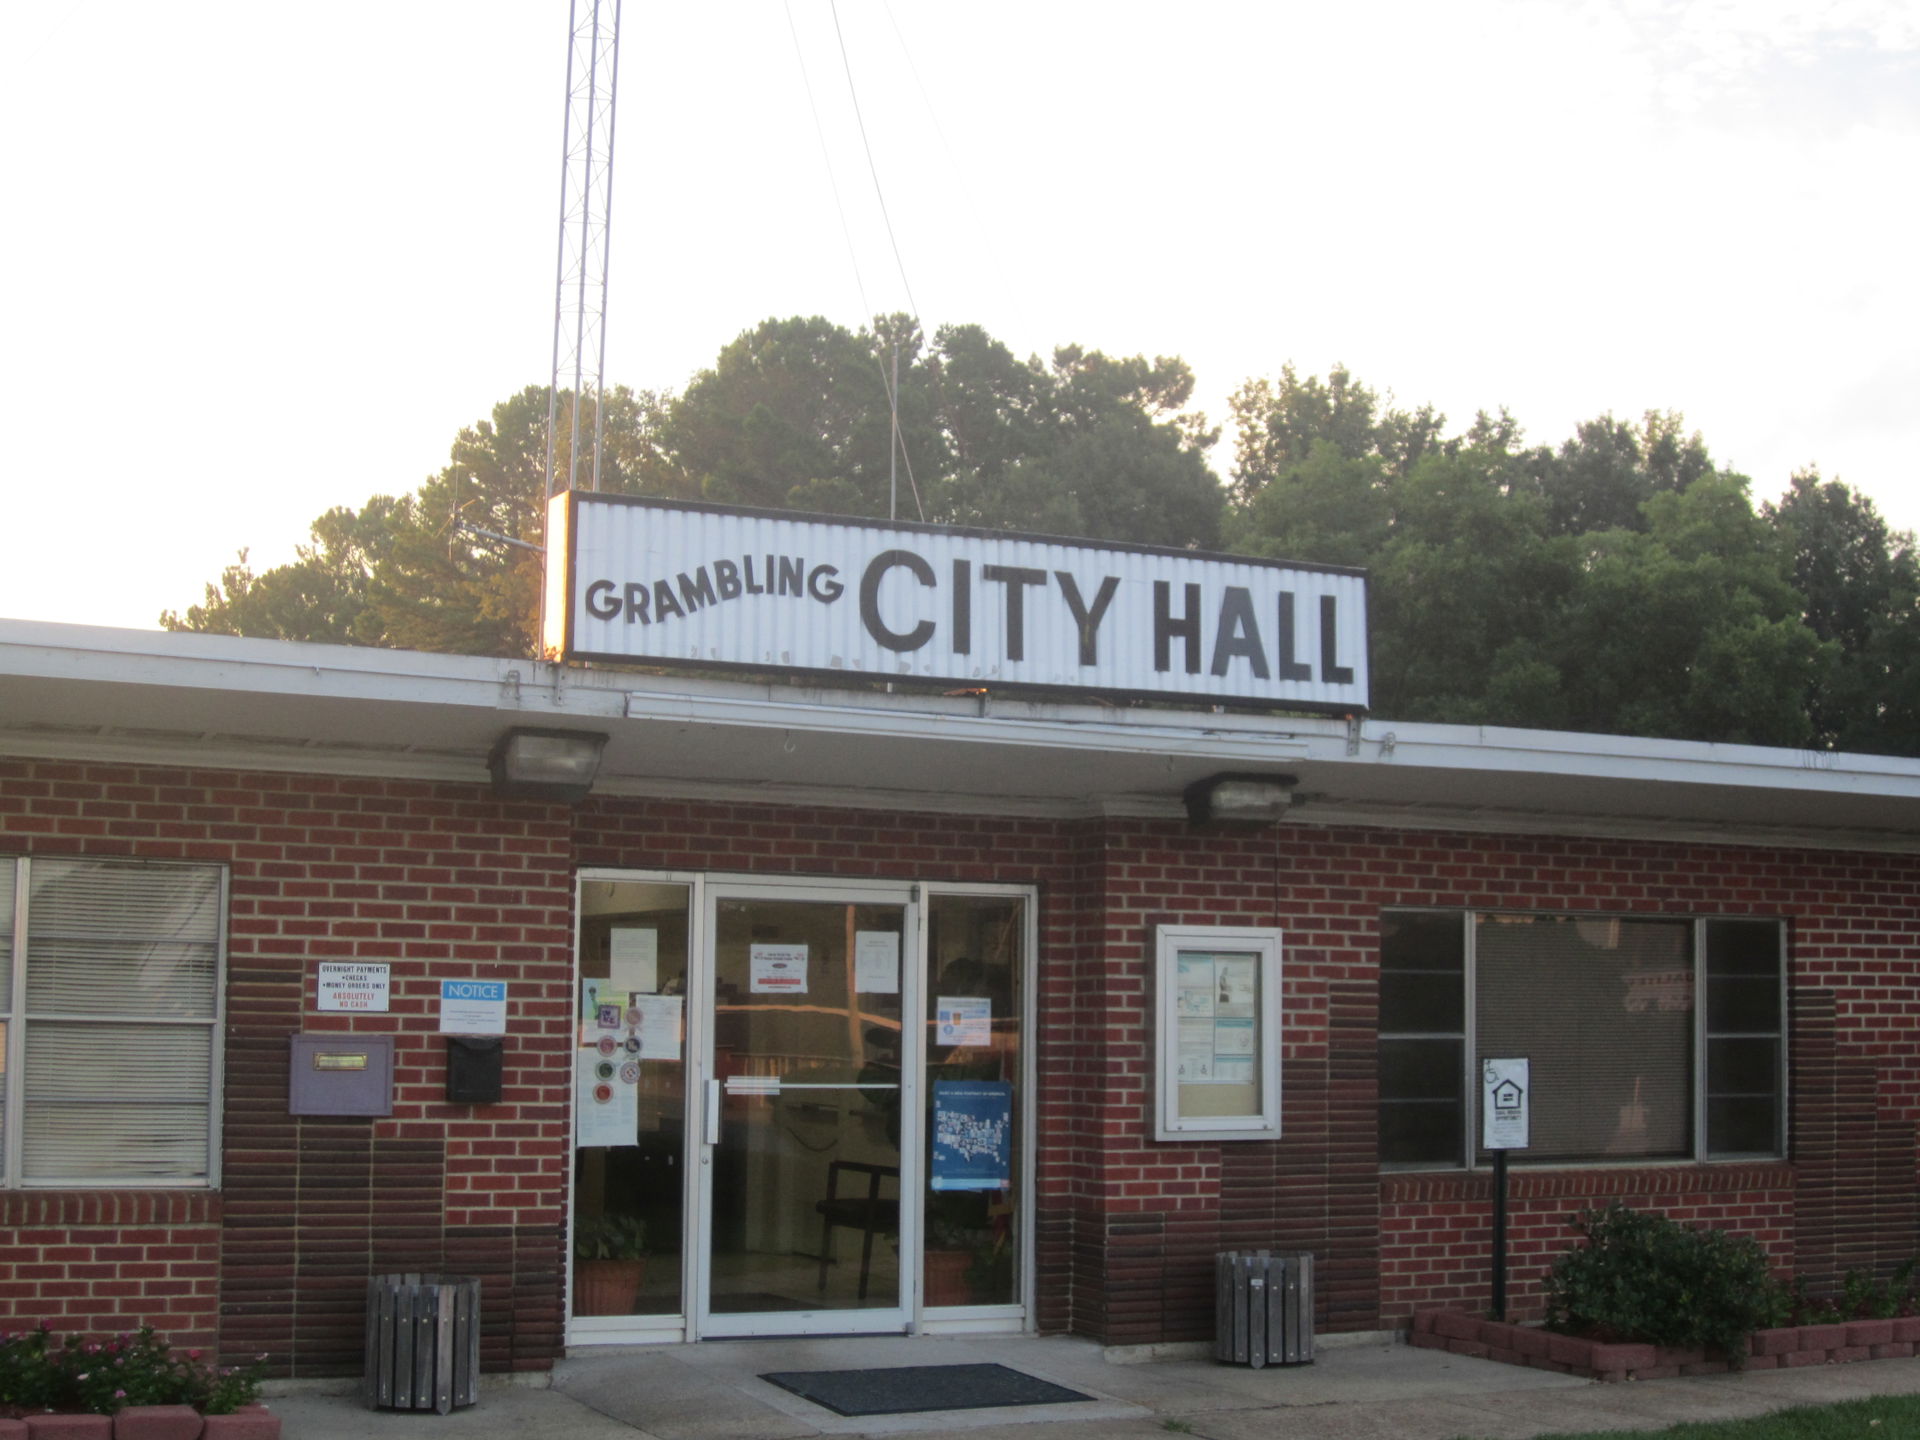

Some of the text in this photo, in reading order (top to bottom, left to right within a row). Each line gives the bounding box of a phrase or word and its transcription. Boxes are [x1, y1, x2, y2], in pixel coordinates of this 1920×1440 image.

[585, 550, 1354, 685] GRAMBLING CITY HALL
[322, 965, 387, 974] OVERNIGHT PAYMENTS
[333, 992, 374, 1000] ABSOLUTELY
[449, 984, 498, 998] NOTICE
